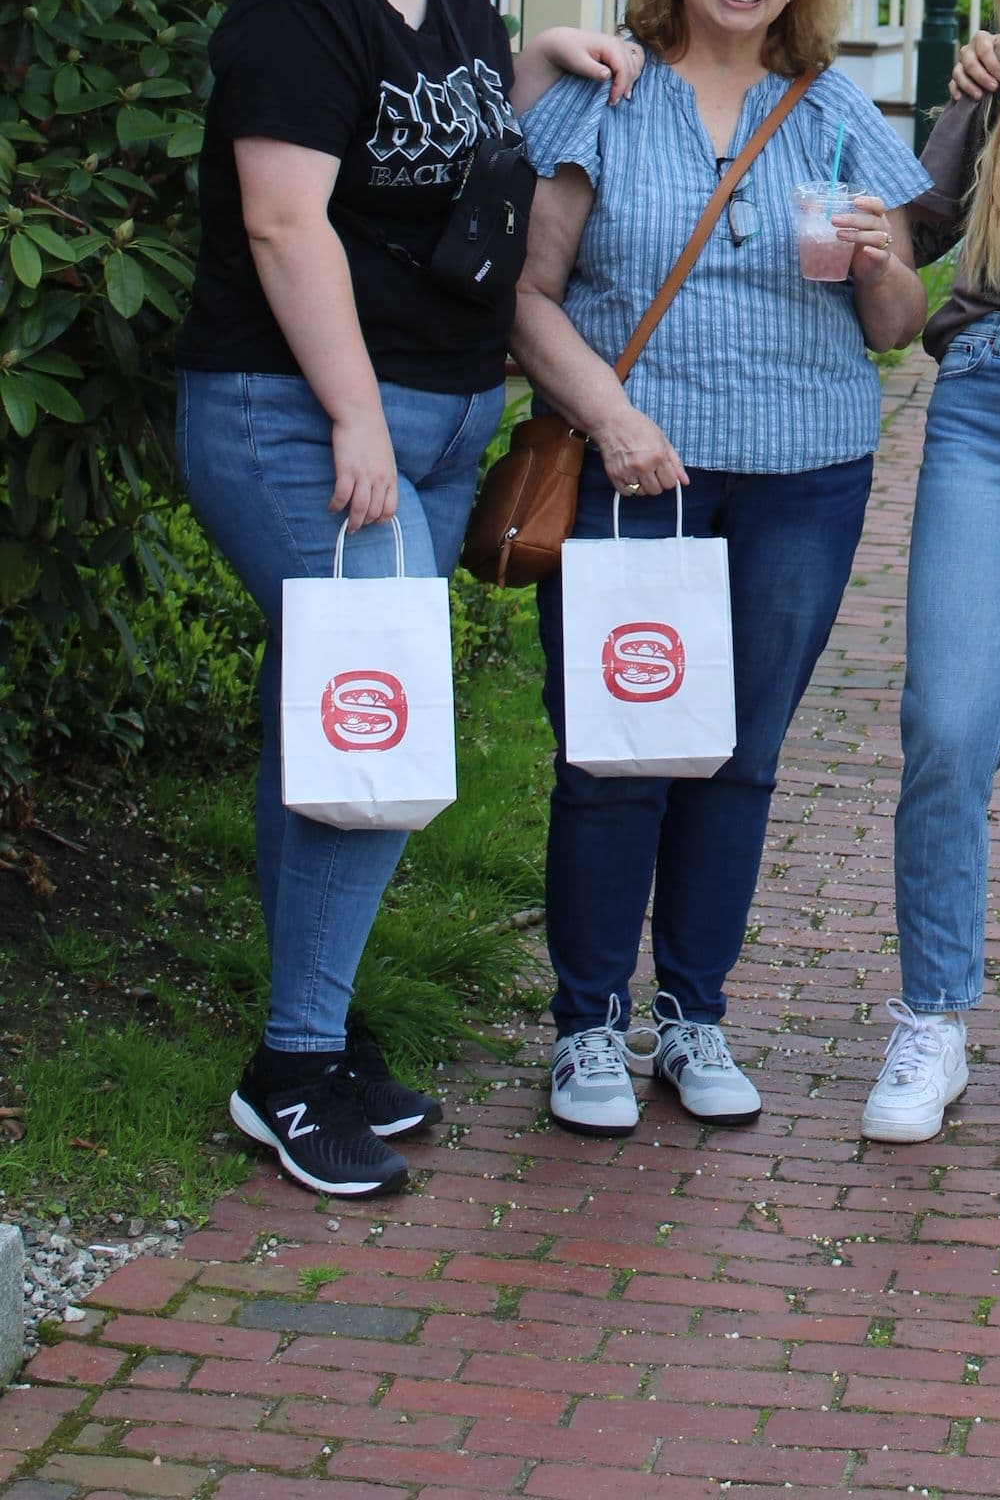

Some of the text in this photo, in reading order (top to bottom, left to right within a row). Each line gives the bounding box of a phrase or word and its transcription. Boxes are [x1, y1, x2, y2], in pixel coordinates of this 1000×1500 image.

[368, 164, 453, 186] BACK
[614, 633, 675, 693] S
[333, 680, 399, 743] S
